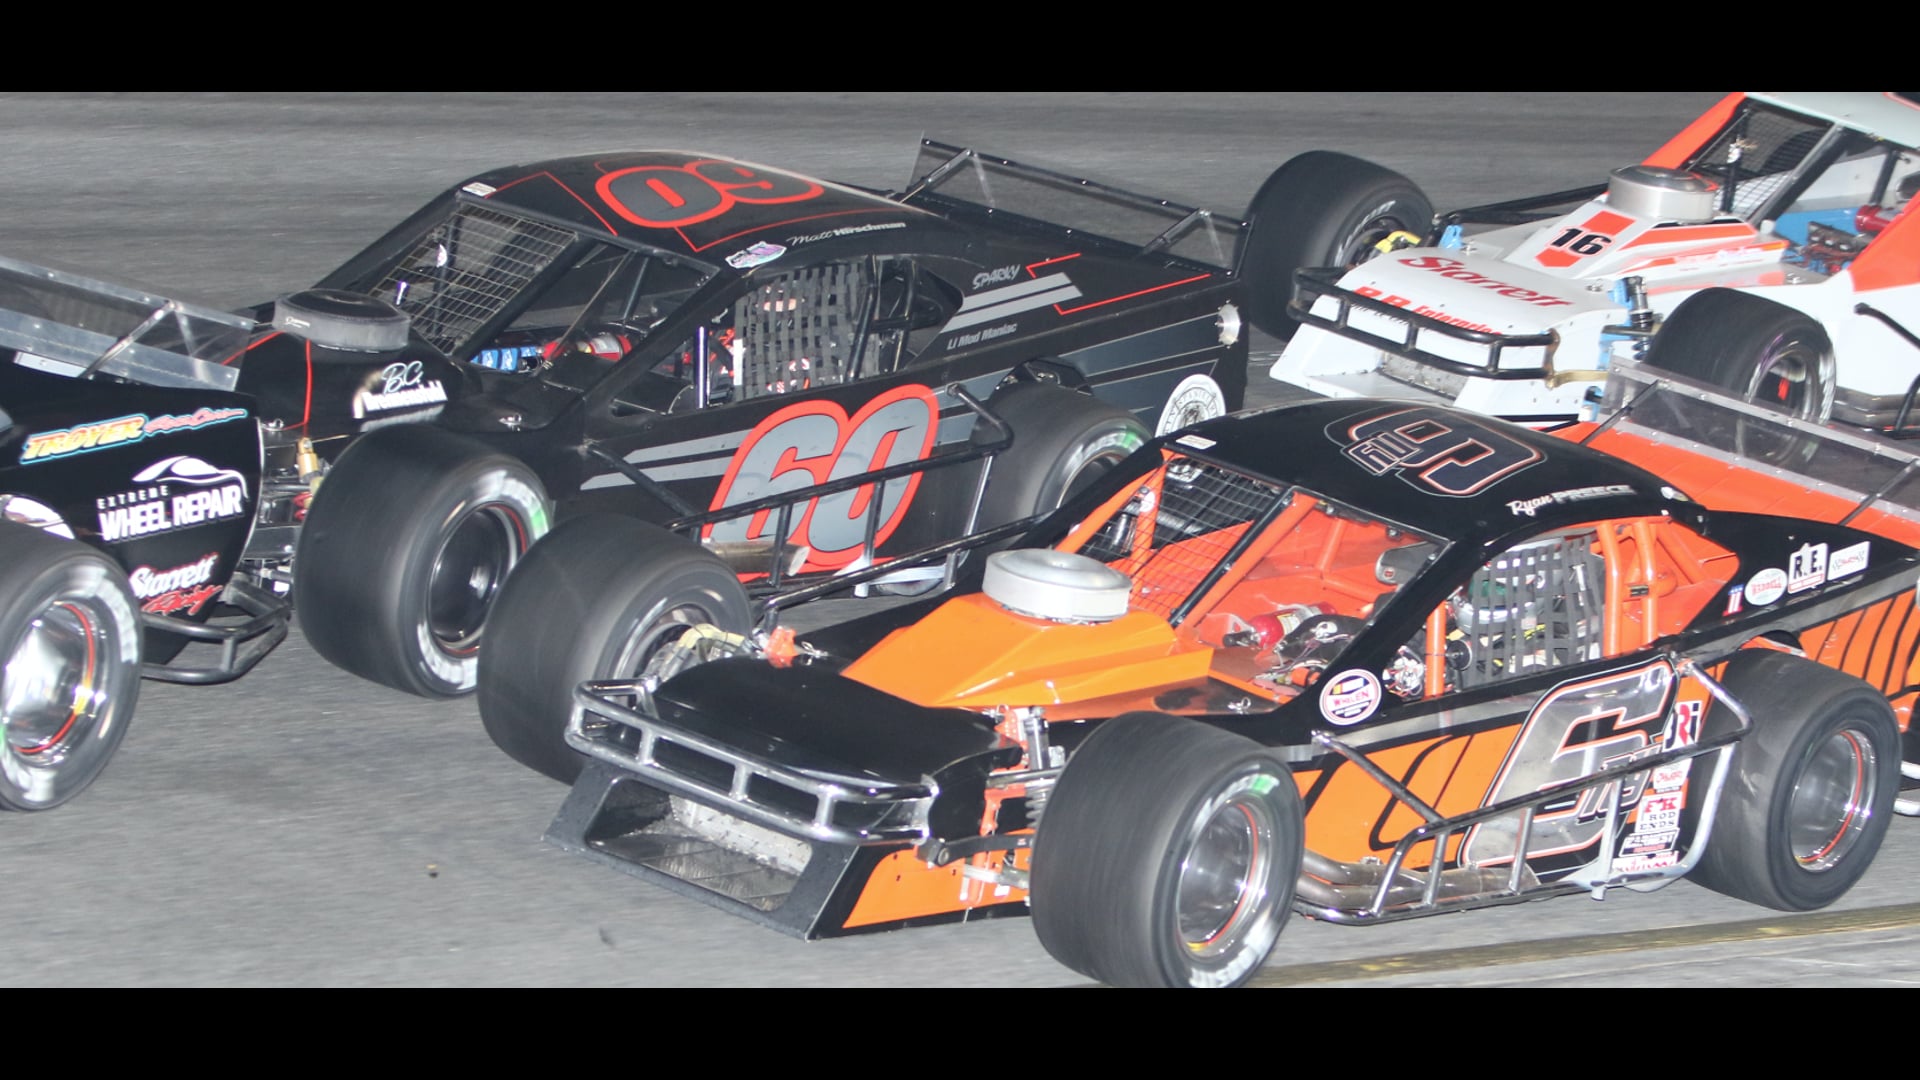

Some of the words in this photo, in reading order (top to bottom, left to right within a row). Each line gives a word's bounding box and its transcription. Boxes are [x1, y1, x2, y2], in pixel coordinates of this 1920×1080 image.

[786, 230, 833, 246] Matt
[1550, 227, 1613, 257] 16
[1397, 256, 1577, 307] Starrett
[20, 414, 148, 462] TROYER
[96, 485, 169, 510] EXTREME
[702, 384, 939, 567] 60
[99, 500, 172, 541] WHEEL
[172, 484, 243, 526] REPAIR
[1505, 497, 1554, 517] Ryan
[128, 552, 219, 599] Starrett
[1456, 655, 1677, 868] 6
